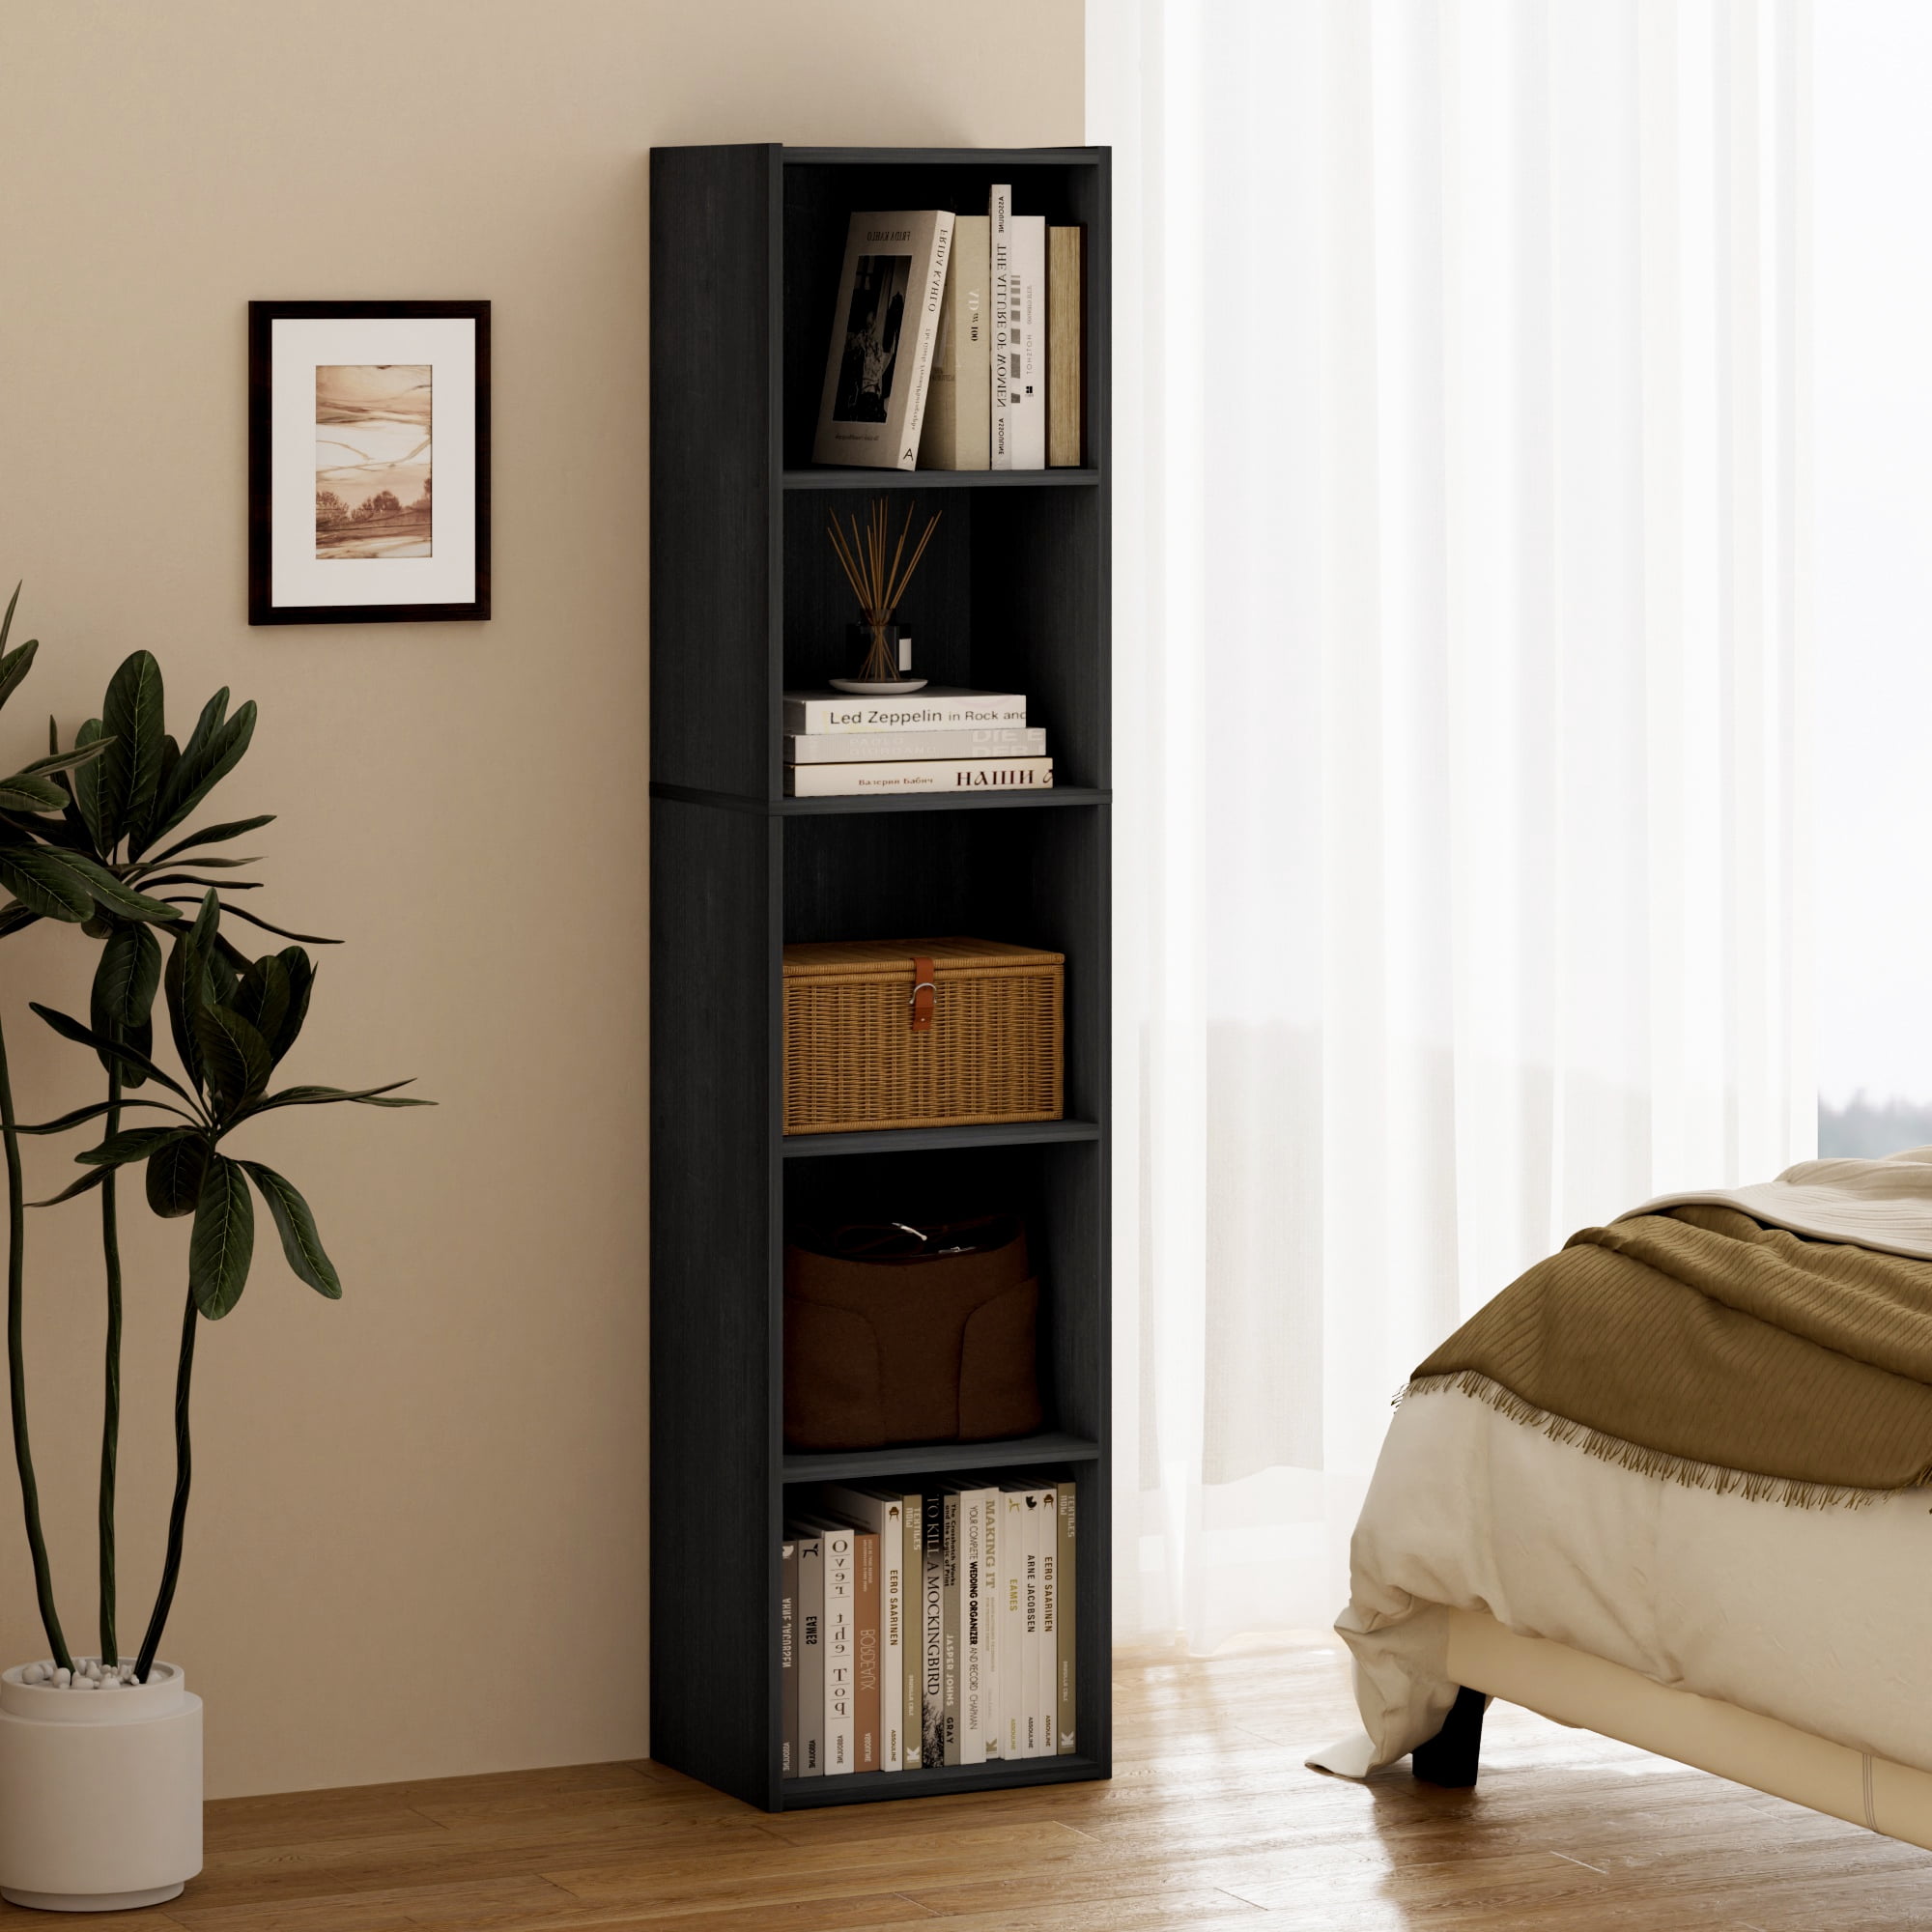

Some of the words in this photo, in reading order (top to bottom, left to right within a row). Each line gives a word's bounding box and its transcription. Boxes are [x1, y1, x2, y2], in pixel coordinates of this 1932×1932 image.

[830, 711, 862, 724] Led
[867, 709, 943, 726] Zeppelin
[948, 711, 961, 721] in
[965, 711, 1000, 721] Rock
[926, 1493, 939, 1519] TO
[969, 1505, 978, 1524] YOUR
[926, 1522, 940, 1558] KILL
[969, 1525, 978, 1560] COMPLETE
[985, 1499, 996, 1568] MAKING
[890, 1570, 898, 1594] EERO
[926, 1560, 940, 1572] A
[969, 1561, 978, 1599] WEDDING
[985, 1573, 996, 1588] IT
[1027, 1554, 1036, 1580] ARNE
[1044, 1556, 1053, 1580] EERO
[1009, 1578, 1018, 1611] EAMES
[1027, 1583, 1036, 1633] JACOBSEN
[1044, 1584, 1053, 1633] SAARINEN
[890, 1598, 898, 1646] SAARINEN
[927, 1576, 940, 1695] MOCKINGBIRD
[969, 1600, 978, 1645] ORGANIZER
[946, 1634, 954, 1670] JASPER
[969, 1647, 978, 1662] AND
[946, 1673, 954, 1707] JOHNS
[969, 1664, 978, 1691] RECORD
[969, 1694, 978, 1730] CHAPMAN
[946, 1717, 954, 1744] GRAY
